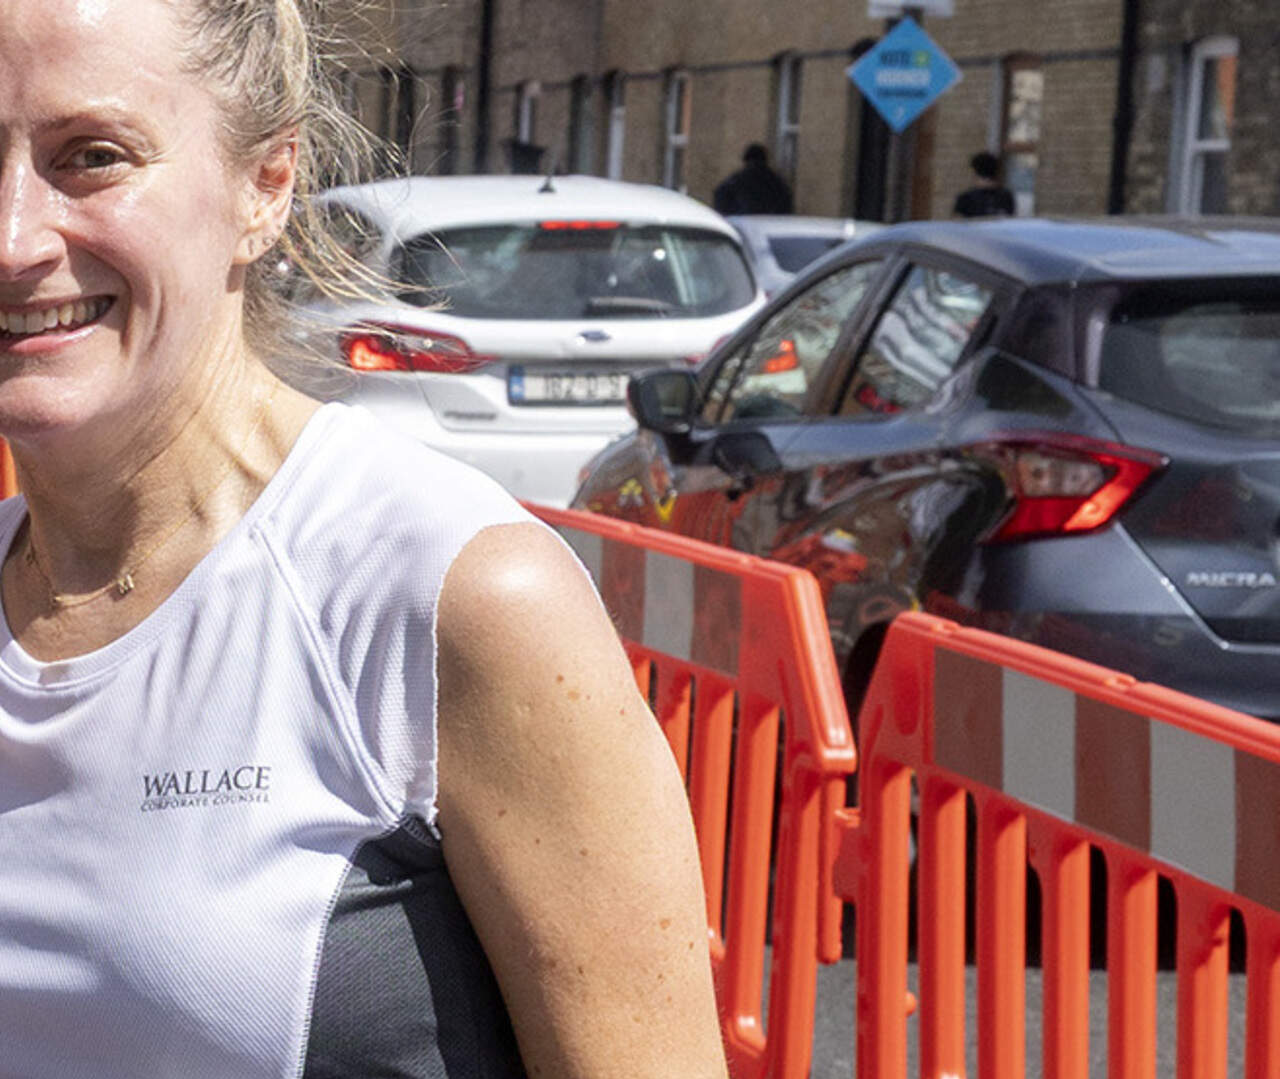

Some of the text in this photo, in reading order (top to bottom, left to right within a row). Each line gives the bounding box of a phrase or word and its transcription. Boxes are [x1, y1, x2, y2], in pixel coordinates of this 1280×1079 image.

[1187, 572, 1277, 588] MICRA
[143, 766, 271, 797] WALLACE
[141, 794, 270, 812] CORPORATE COUNSEL
